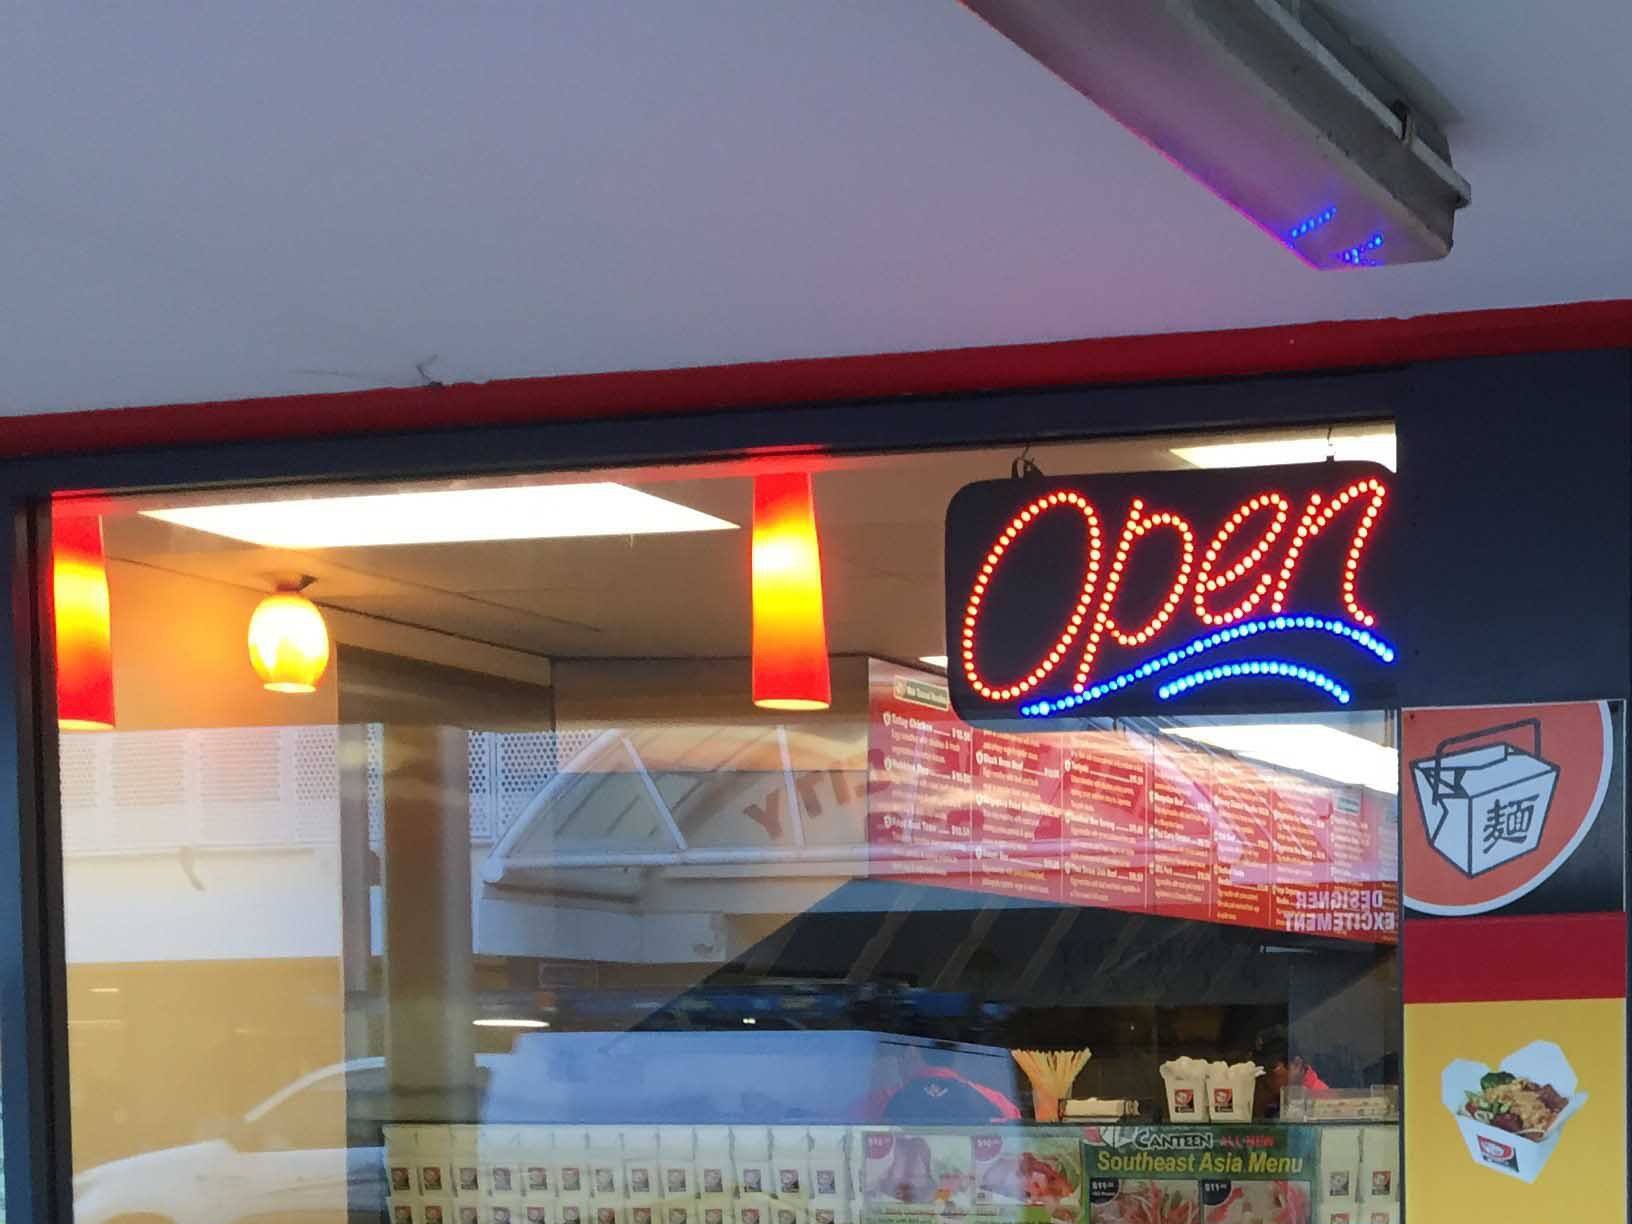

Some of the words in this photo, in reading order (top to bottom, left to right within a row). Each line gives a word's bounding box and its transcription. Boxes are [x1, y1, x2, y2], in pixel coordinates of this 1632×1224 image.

[962, 478, 1386, 700] Open
[1133, 1129, 1214, 1151] CANTEEN
[1097, 1151, 1194, 1173] Southeast
[1199, 1151, 1243, 1173] Asia
[1248, 1151, 1304, 1174] Menu
